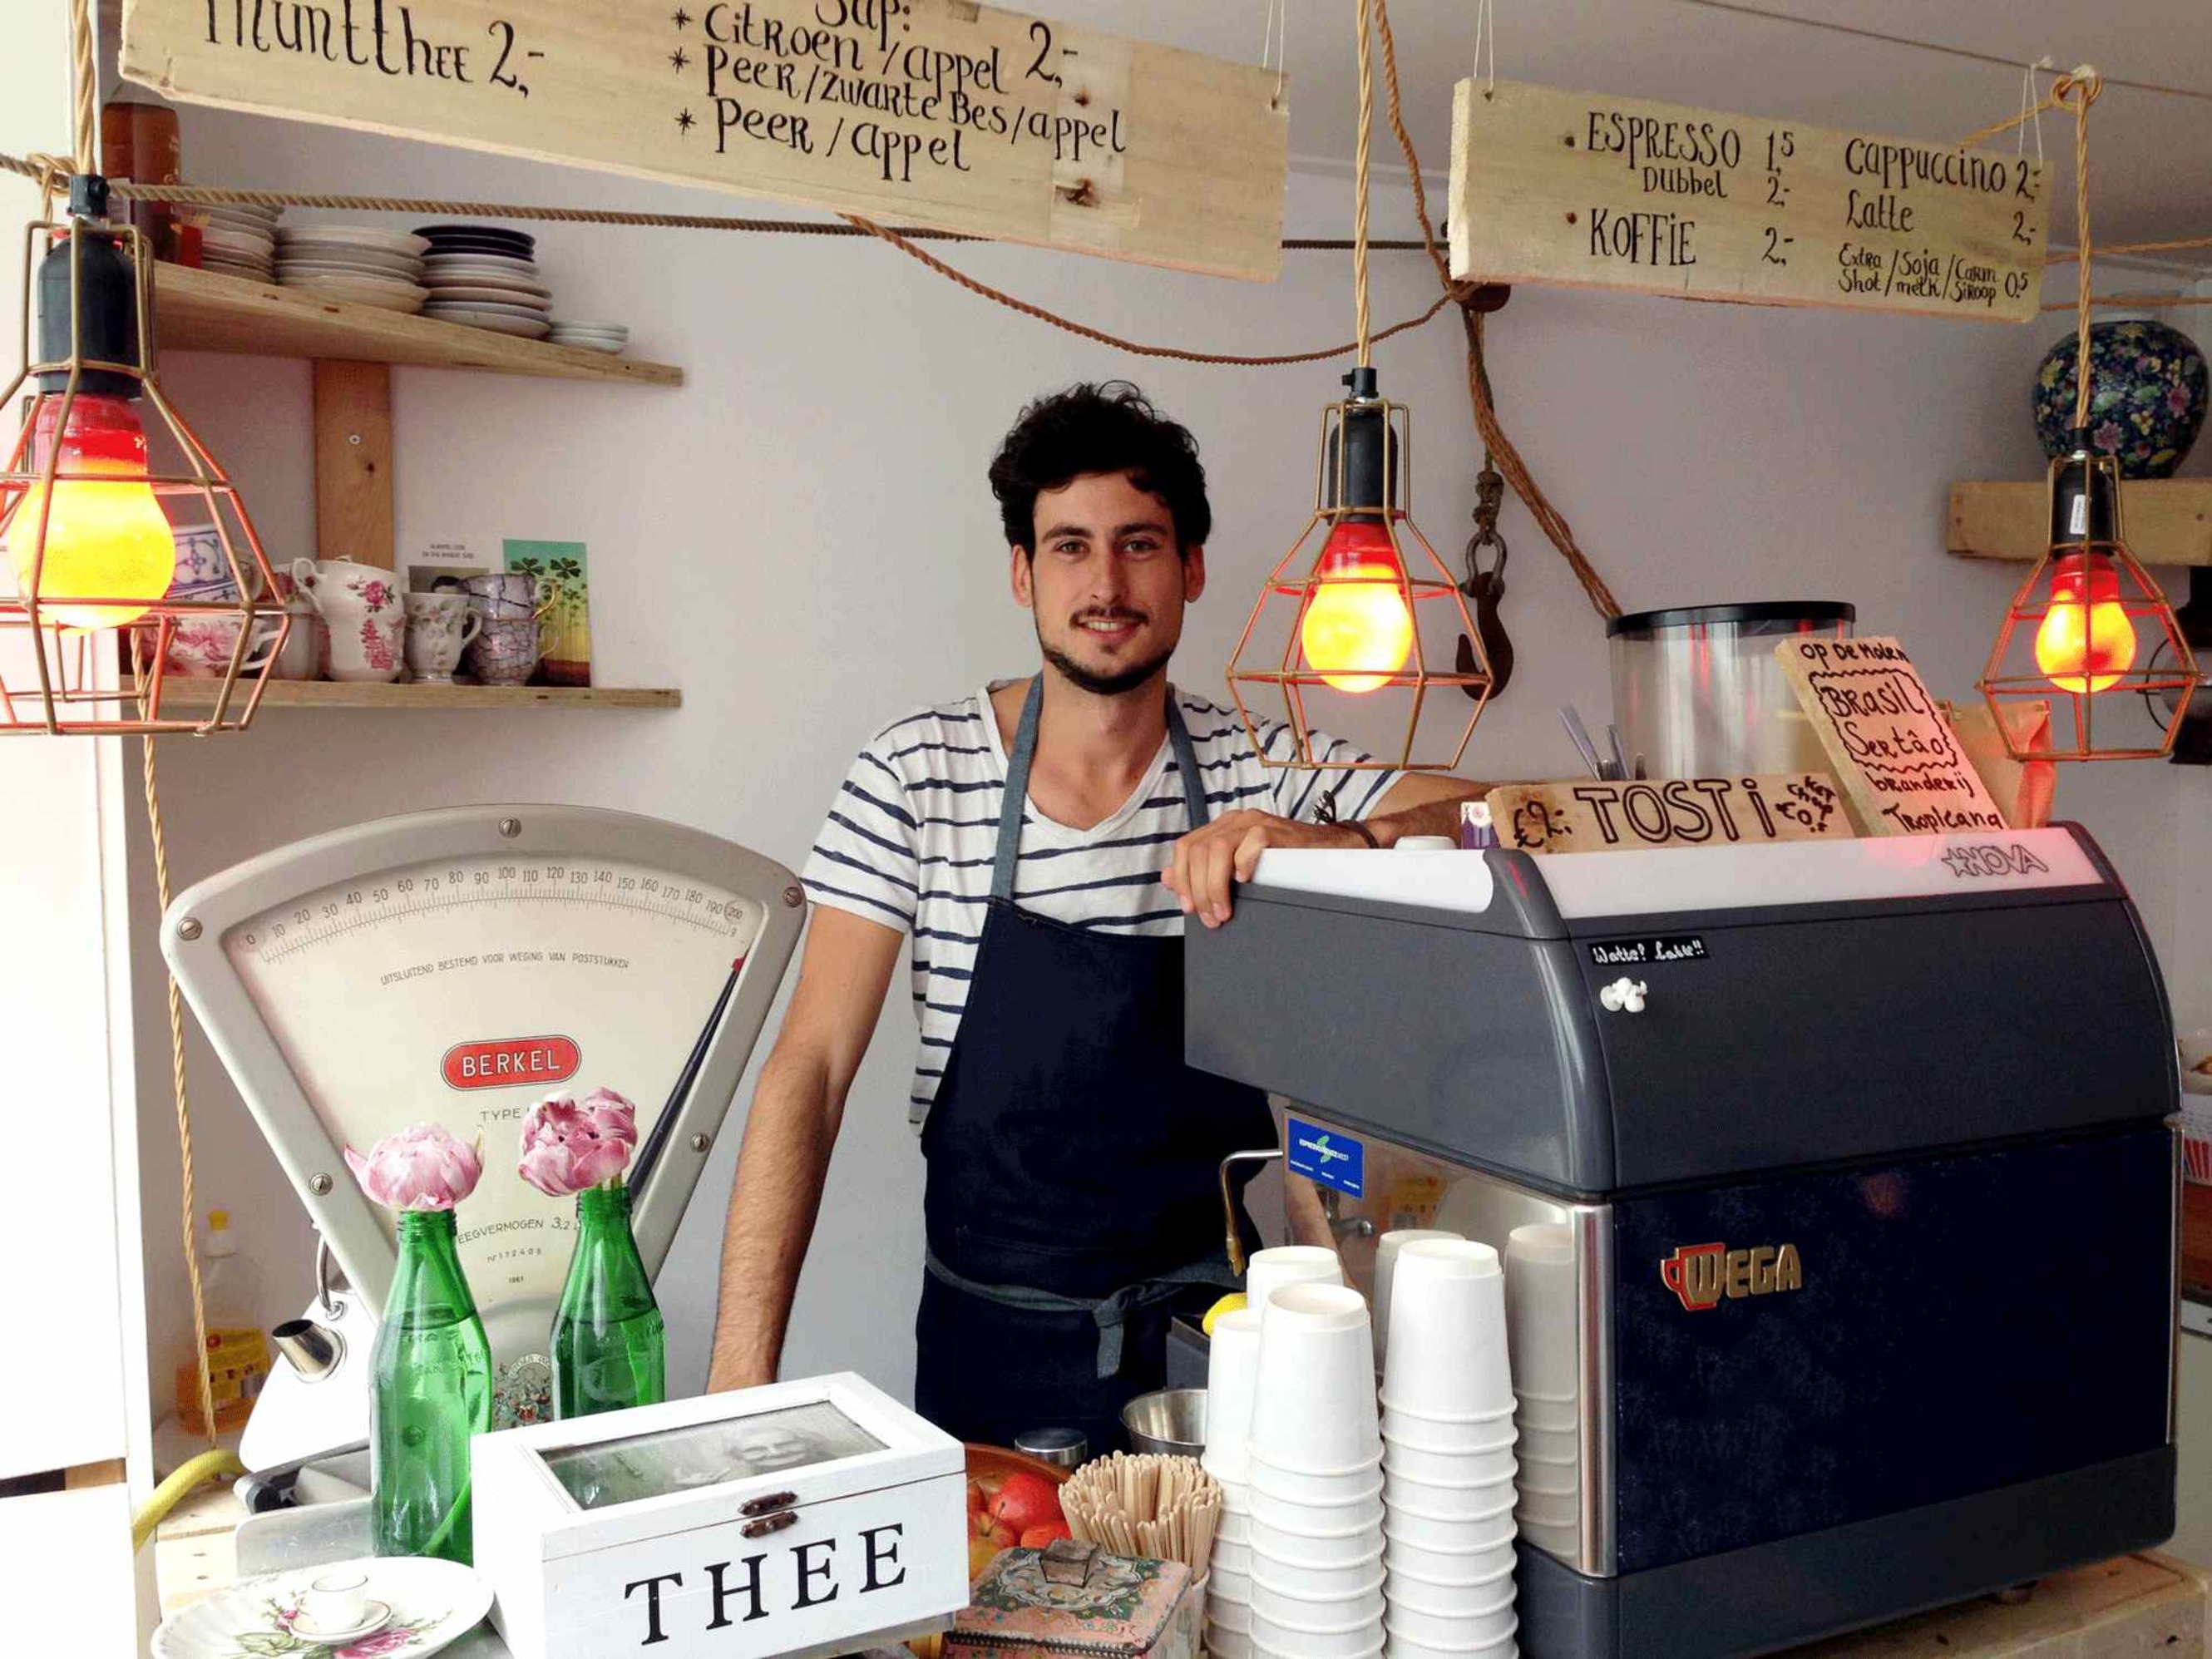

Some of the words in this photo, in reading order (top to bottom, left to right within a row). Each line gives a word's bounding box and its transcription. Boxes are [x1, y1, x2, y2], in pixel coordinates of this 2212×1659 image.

[1587, 111, 1741, 170] ESPRESSO
[1844, 137, 2007, 193] Cappuccino
[1845, 188, 1915, 233] Latte
[1761, 226, 1795, 266] 2,-
[1954, 842, 2051, 877] NOVA
[271, 922, 287, 940] 10
[293, 907, 312, 926] 20
[320, 903, 339, 920] 30
[345, 891, 363, 907] 40
[372, 886, 389, 904] 50
[397, 877, 414, 894] 60
[423, 877, 441, 893] 70
[448, 870, 464, 885] 80
[472, 871, 490, 886] 90
[481, 953, 504, 965] VOOR
[548, 950, 566, 962] VAN
[461, 1048, 563, 1078] BERKEL
[479, 1107, 522, 1123] TYPE
[457, 1217, 545, 1246] EEGVERMOGEN
[1681, 1242, 1803, 1306] WEGA
[624, 1522, 907, 1647] THEE
